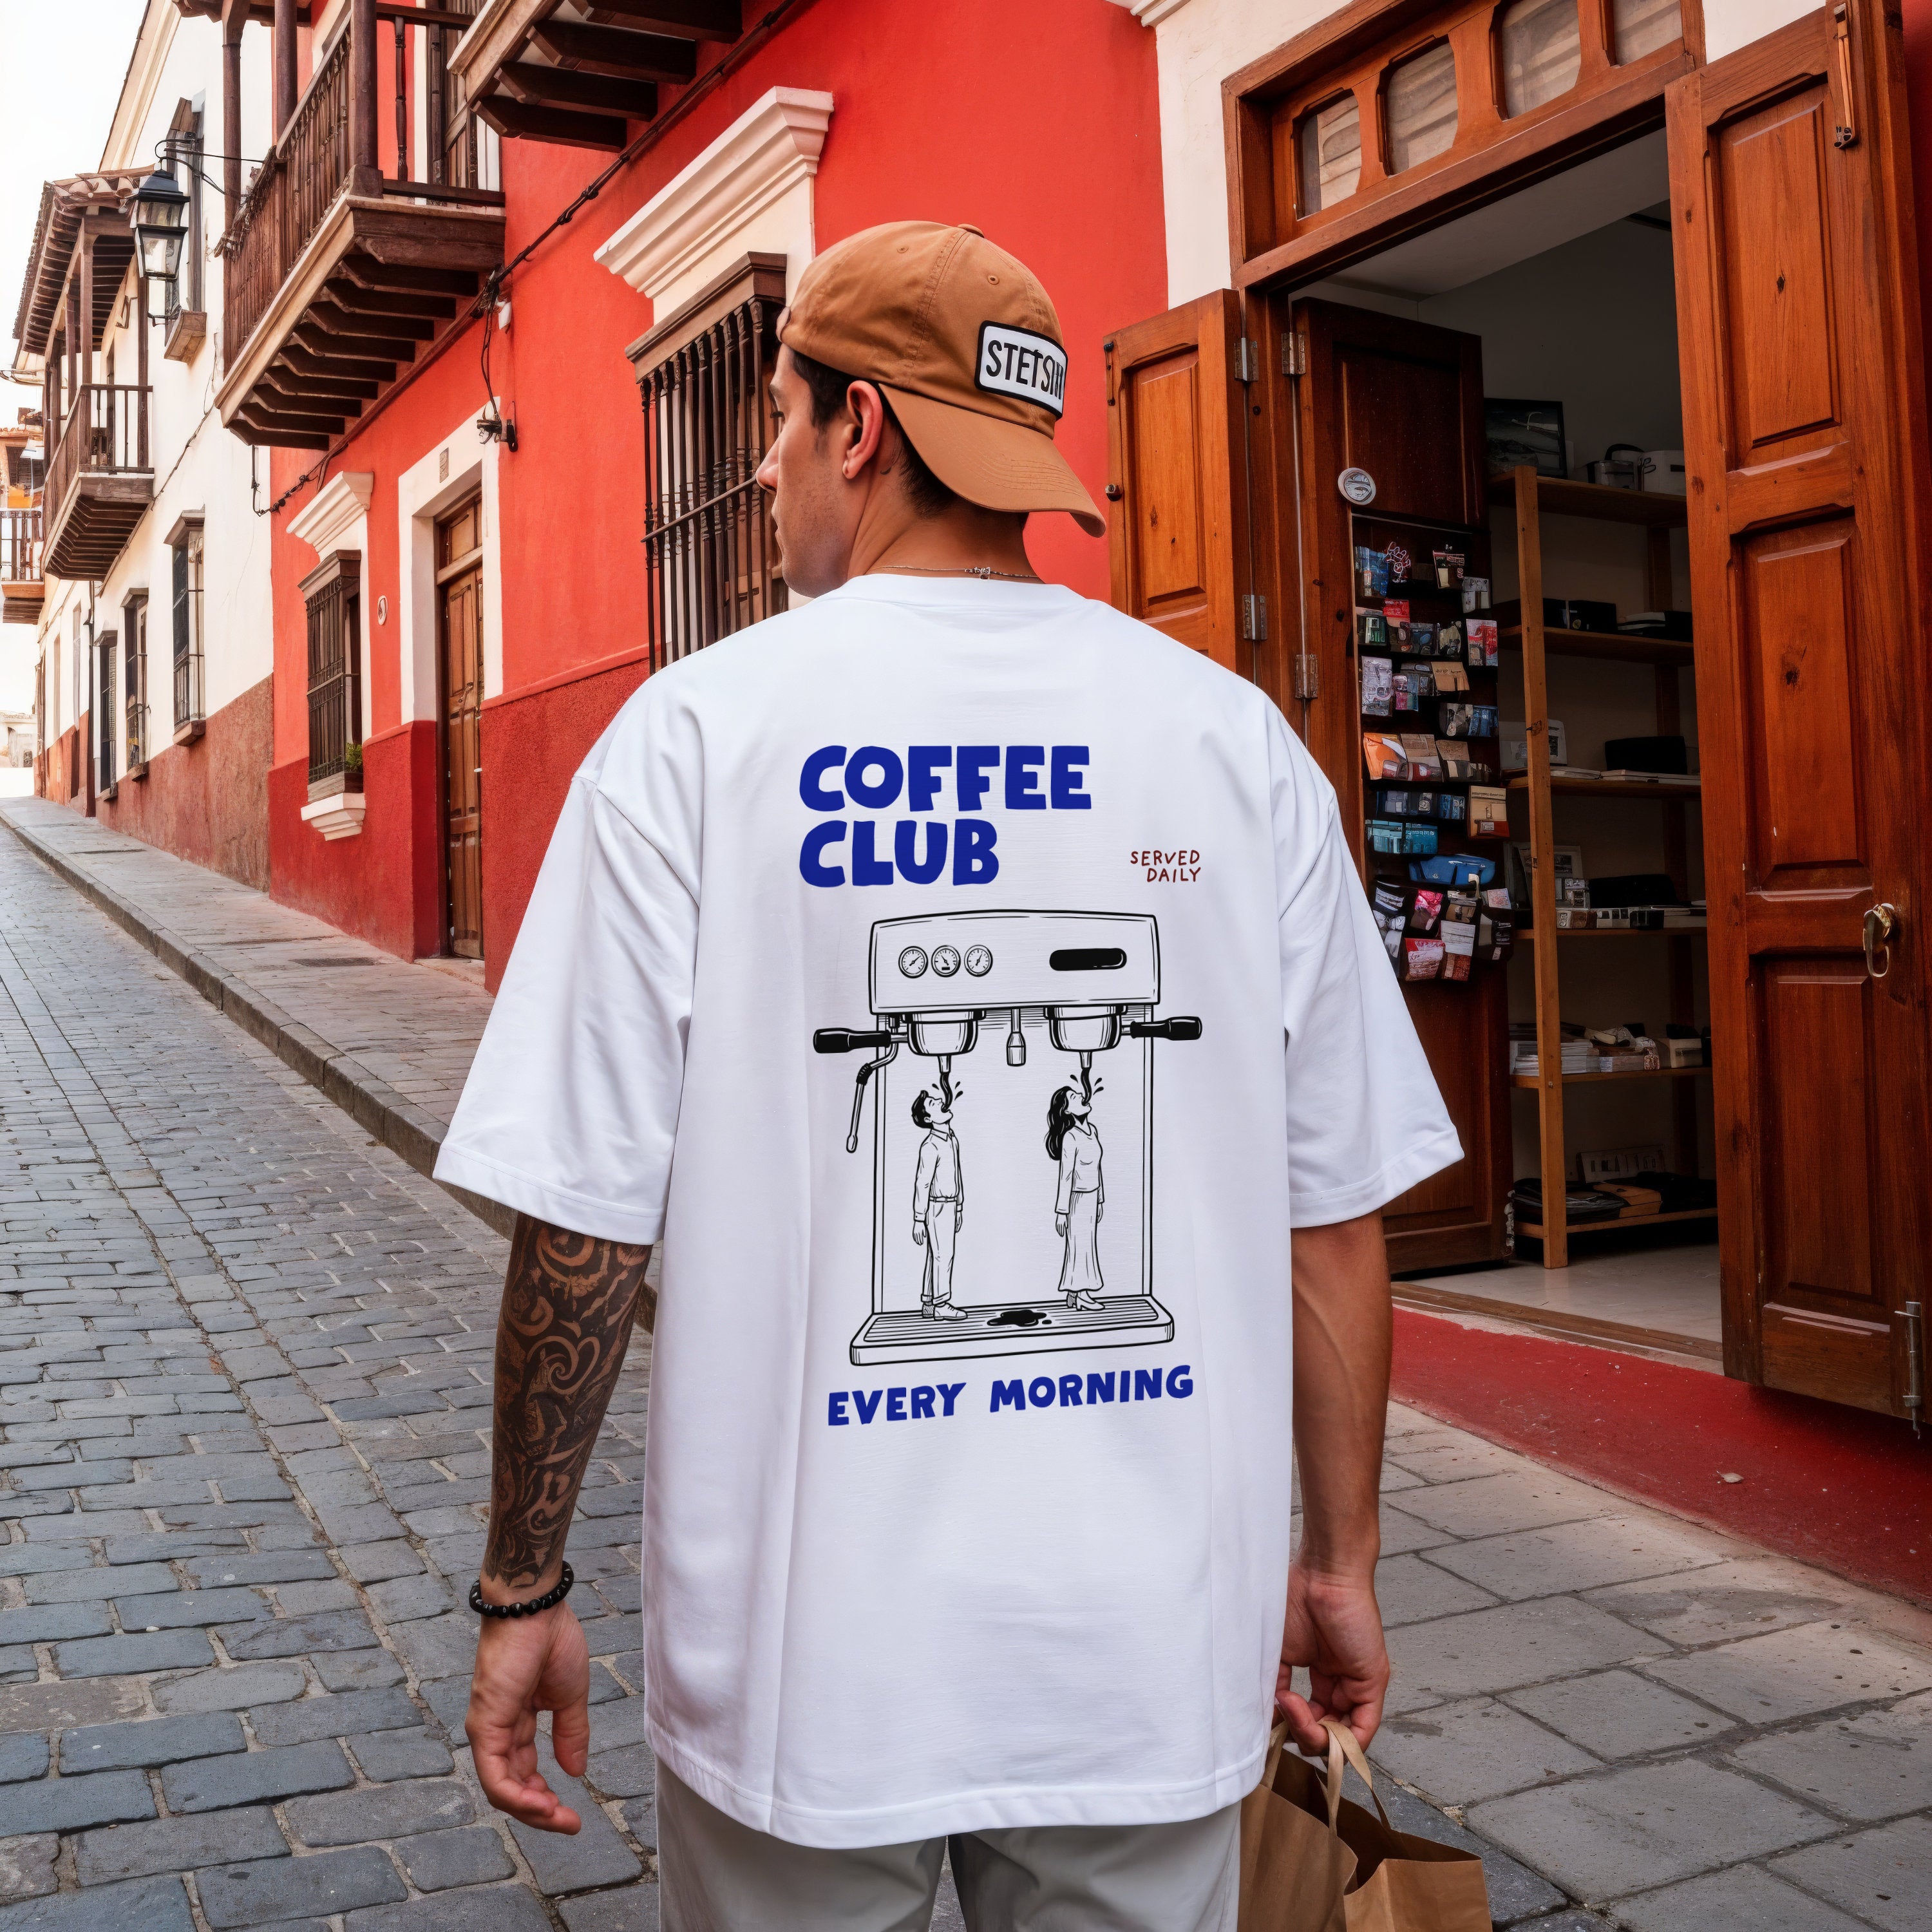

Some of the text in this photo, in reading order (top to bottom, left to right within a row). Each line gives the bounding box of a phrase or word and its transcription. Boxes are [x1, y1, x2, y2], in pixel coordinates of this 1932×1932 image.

[799, 745, 1092, 811] COFFEE
[799, 819, 999, 887] CLUB
[1130, 849, 1200, 866] SERVED
[1146, 867, 1201, 883] DAILY
[828, 1365, 1194, 1426] EVERY MORNING
